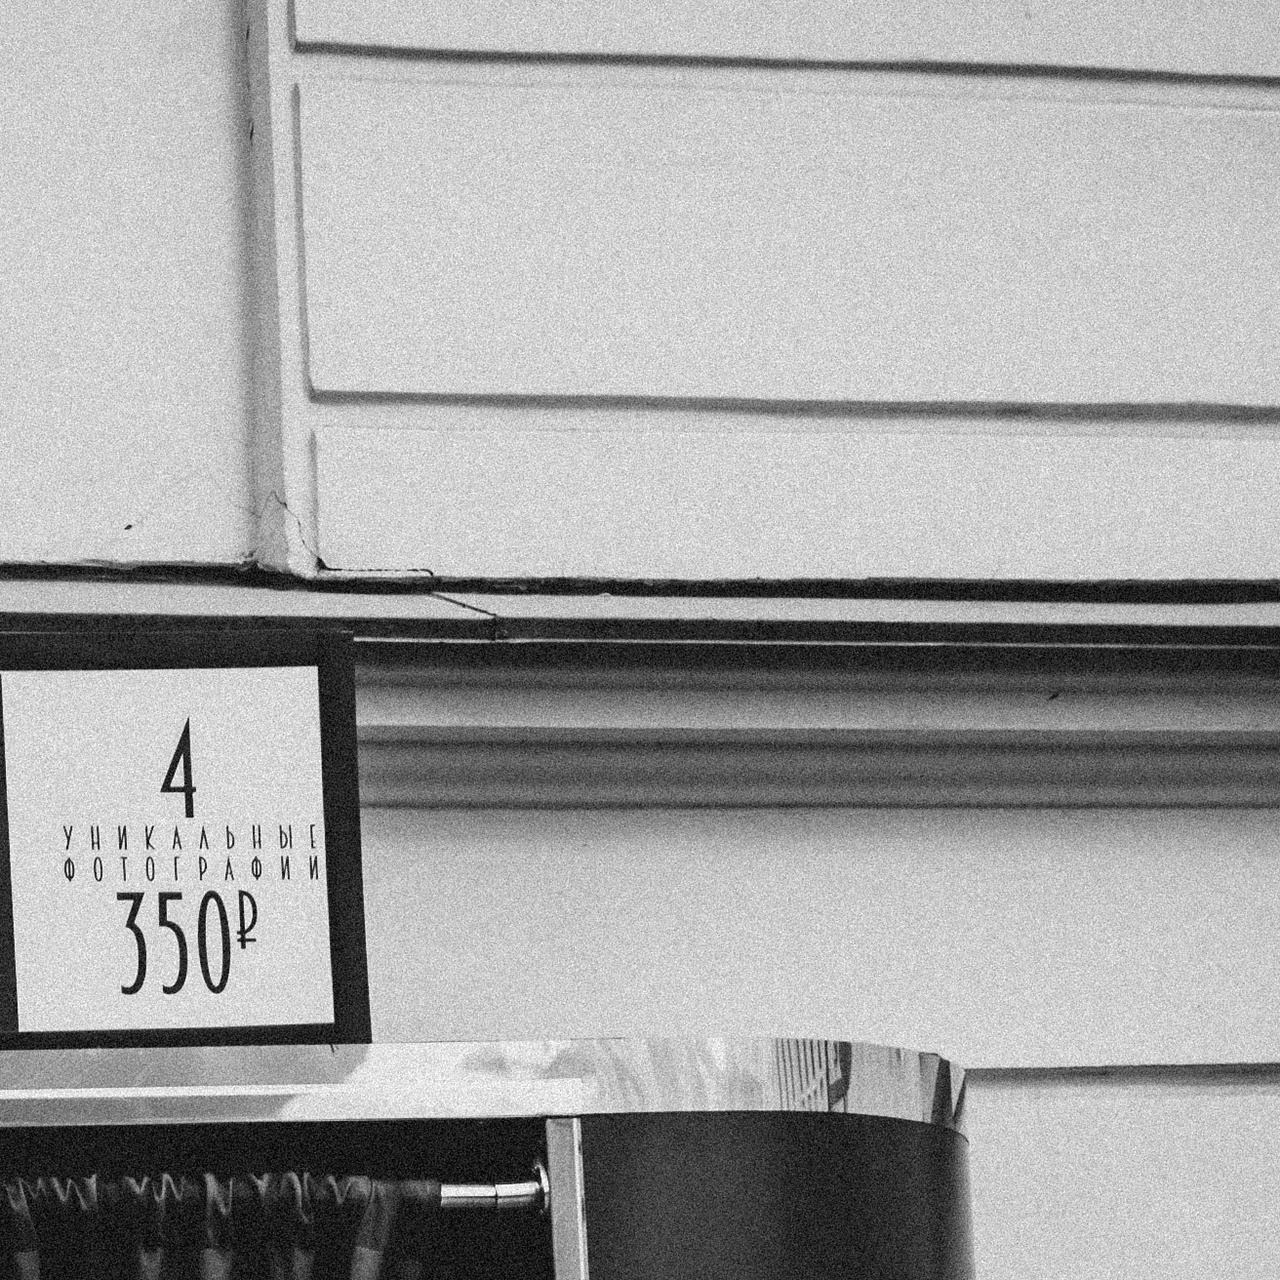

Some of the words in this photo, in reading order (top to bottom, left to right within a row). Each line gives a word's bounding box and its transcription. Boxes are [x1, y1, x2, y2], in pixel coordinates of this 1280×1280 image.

[160, 716, 197, 818] 4
[63, 824, 317, 851] УНИКАЛЬНЫЕ
[63, 855, 320, 882] ФОТОГРАФИИ
